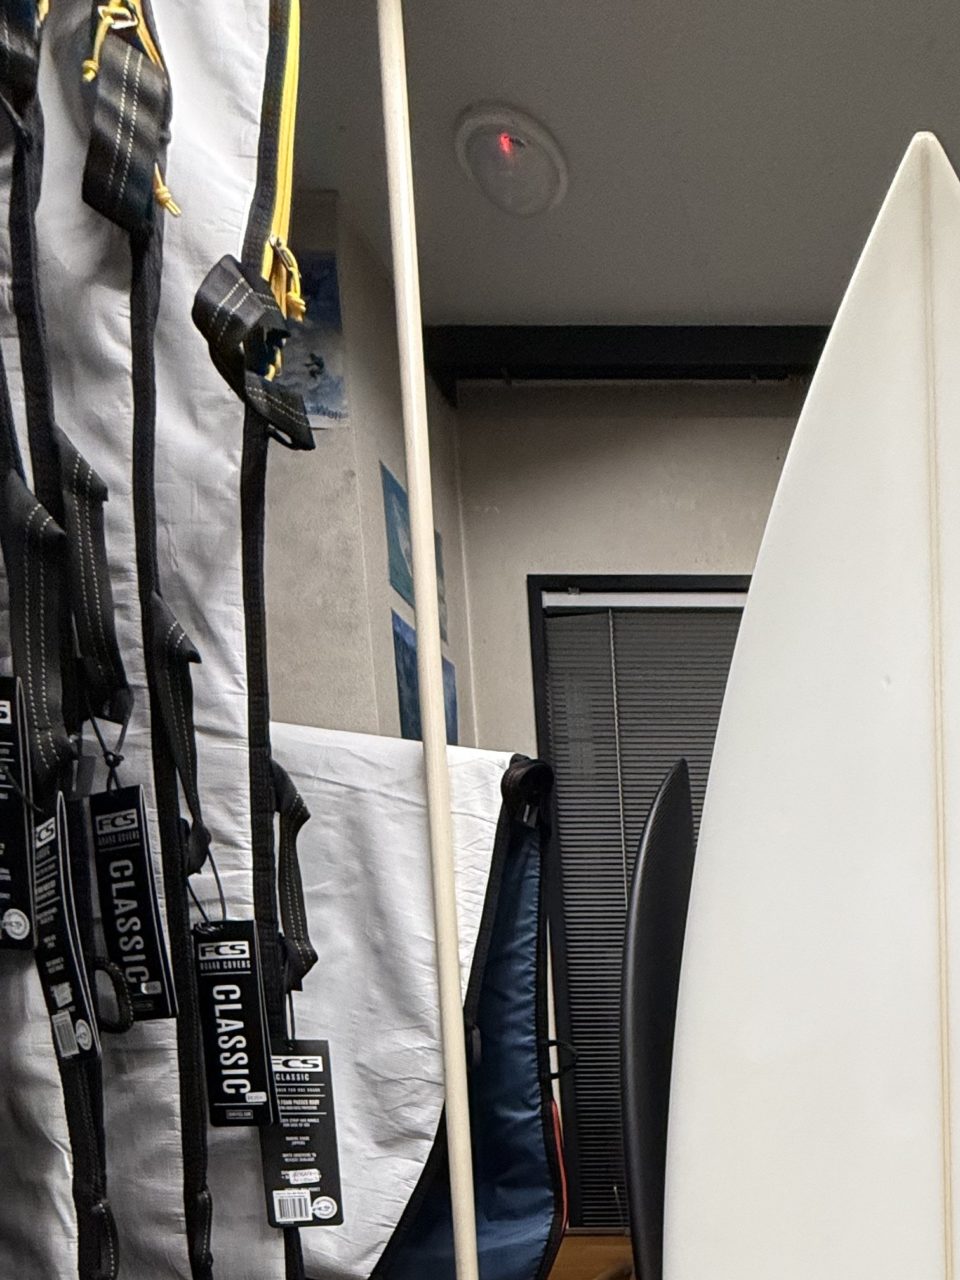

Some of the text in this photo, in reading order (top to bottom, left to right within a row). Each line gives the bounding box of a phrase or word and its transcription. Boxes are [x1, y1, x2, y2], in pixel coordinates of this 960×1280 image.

[98, 812, 136, 832] FCS
[108, 859, 150, 984] CLASSIC
[200, 944, 247, 957] FCS
[212, 984, 251, 1095] CLASSIC
[275, 1073, 310, 1081] CLASSIC
